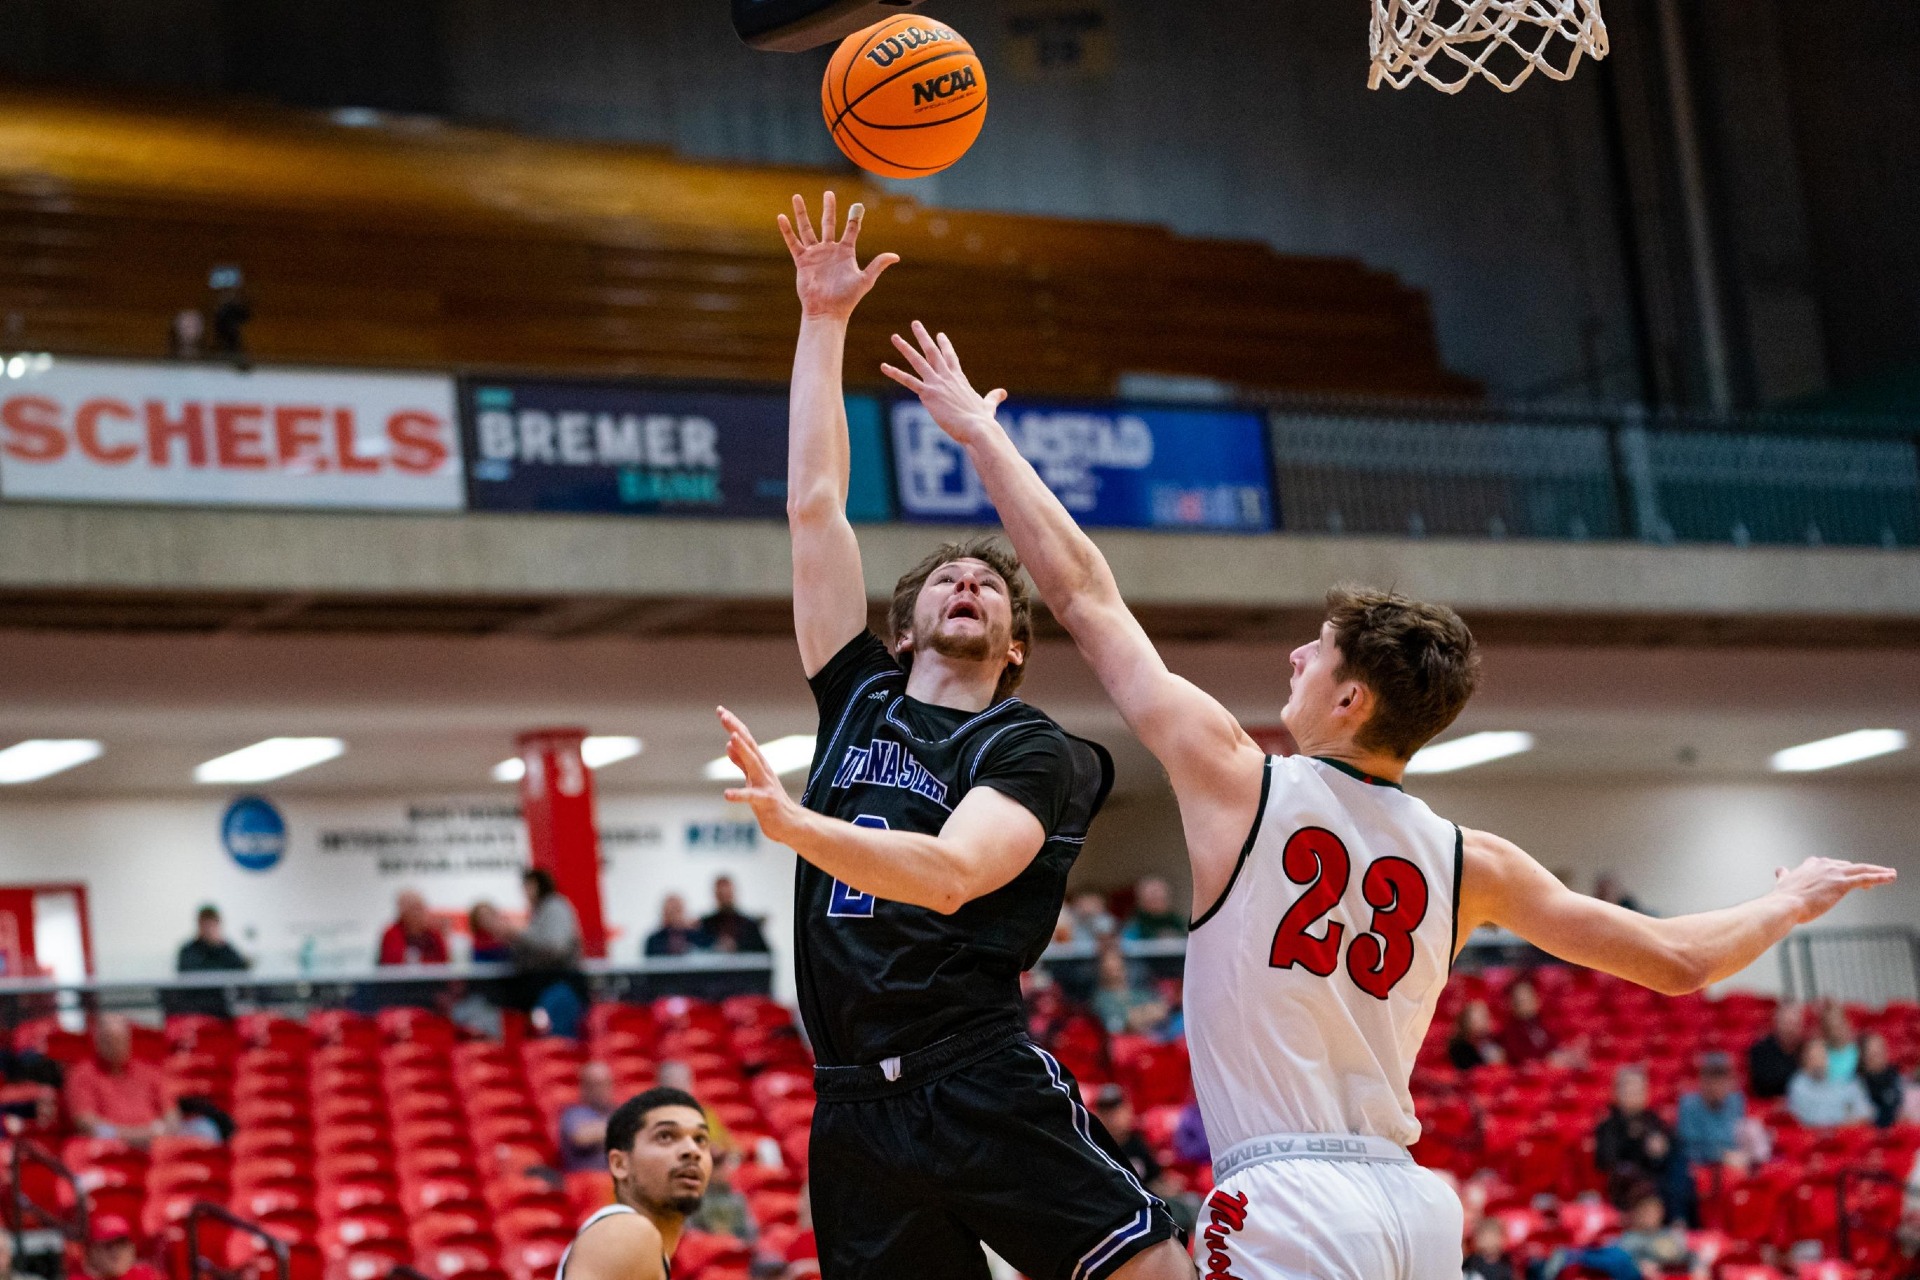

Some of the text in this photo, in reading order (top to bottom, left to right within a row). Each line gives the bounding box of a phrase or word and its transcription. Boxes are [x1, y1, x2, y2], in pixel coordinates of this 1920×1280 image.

[912, 66, 977, 106] NCAA
[0, 393, 447, 475] SCHEELS
[476, 410, 718, 466] BREMER
[1268, 825, 1429, 1000] 23
